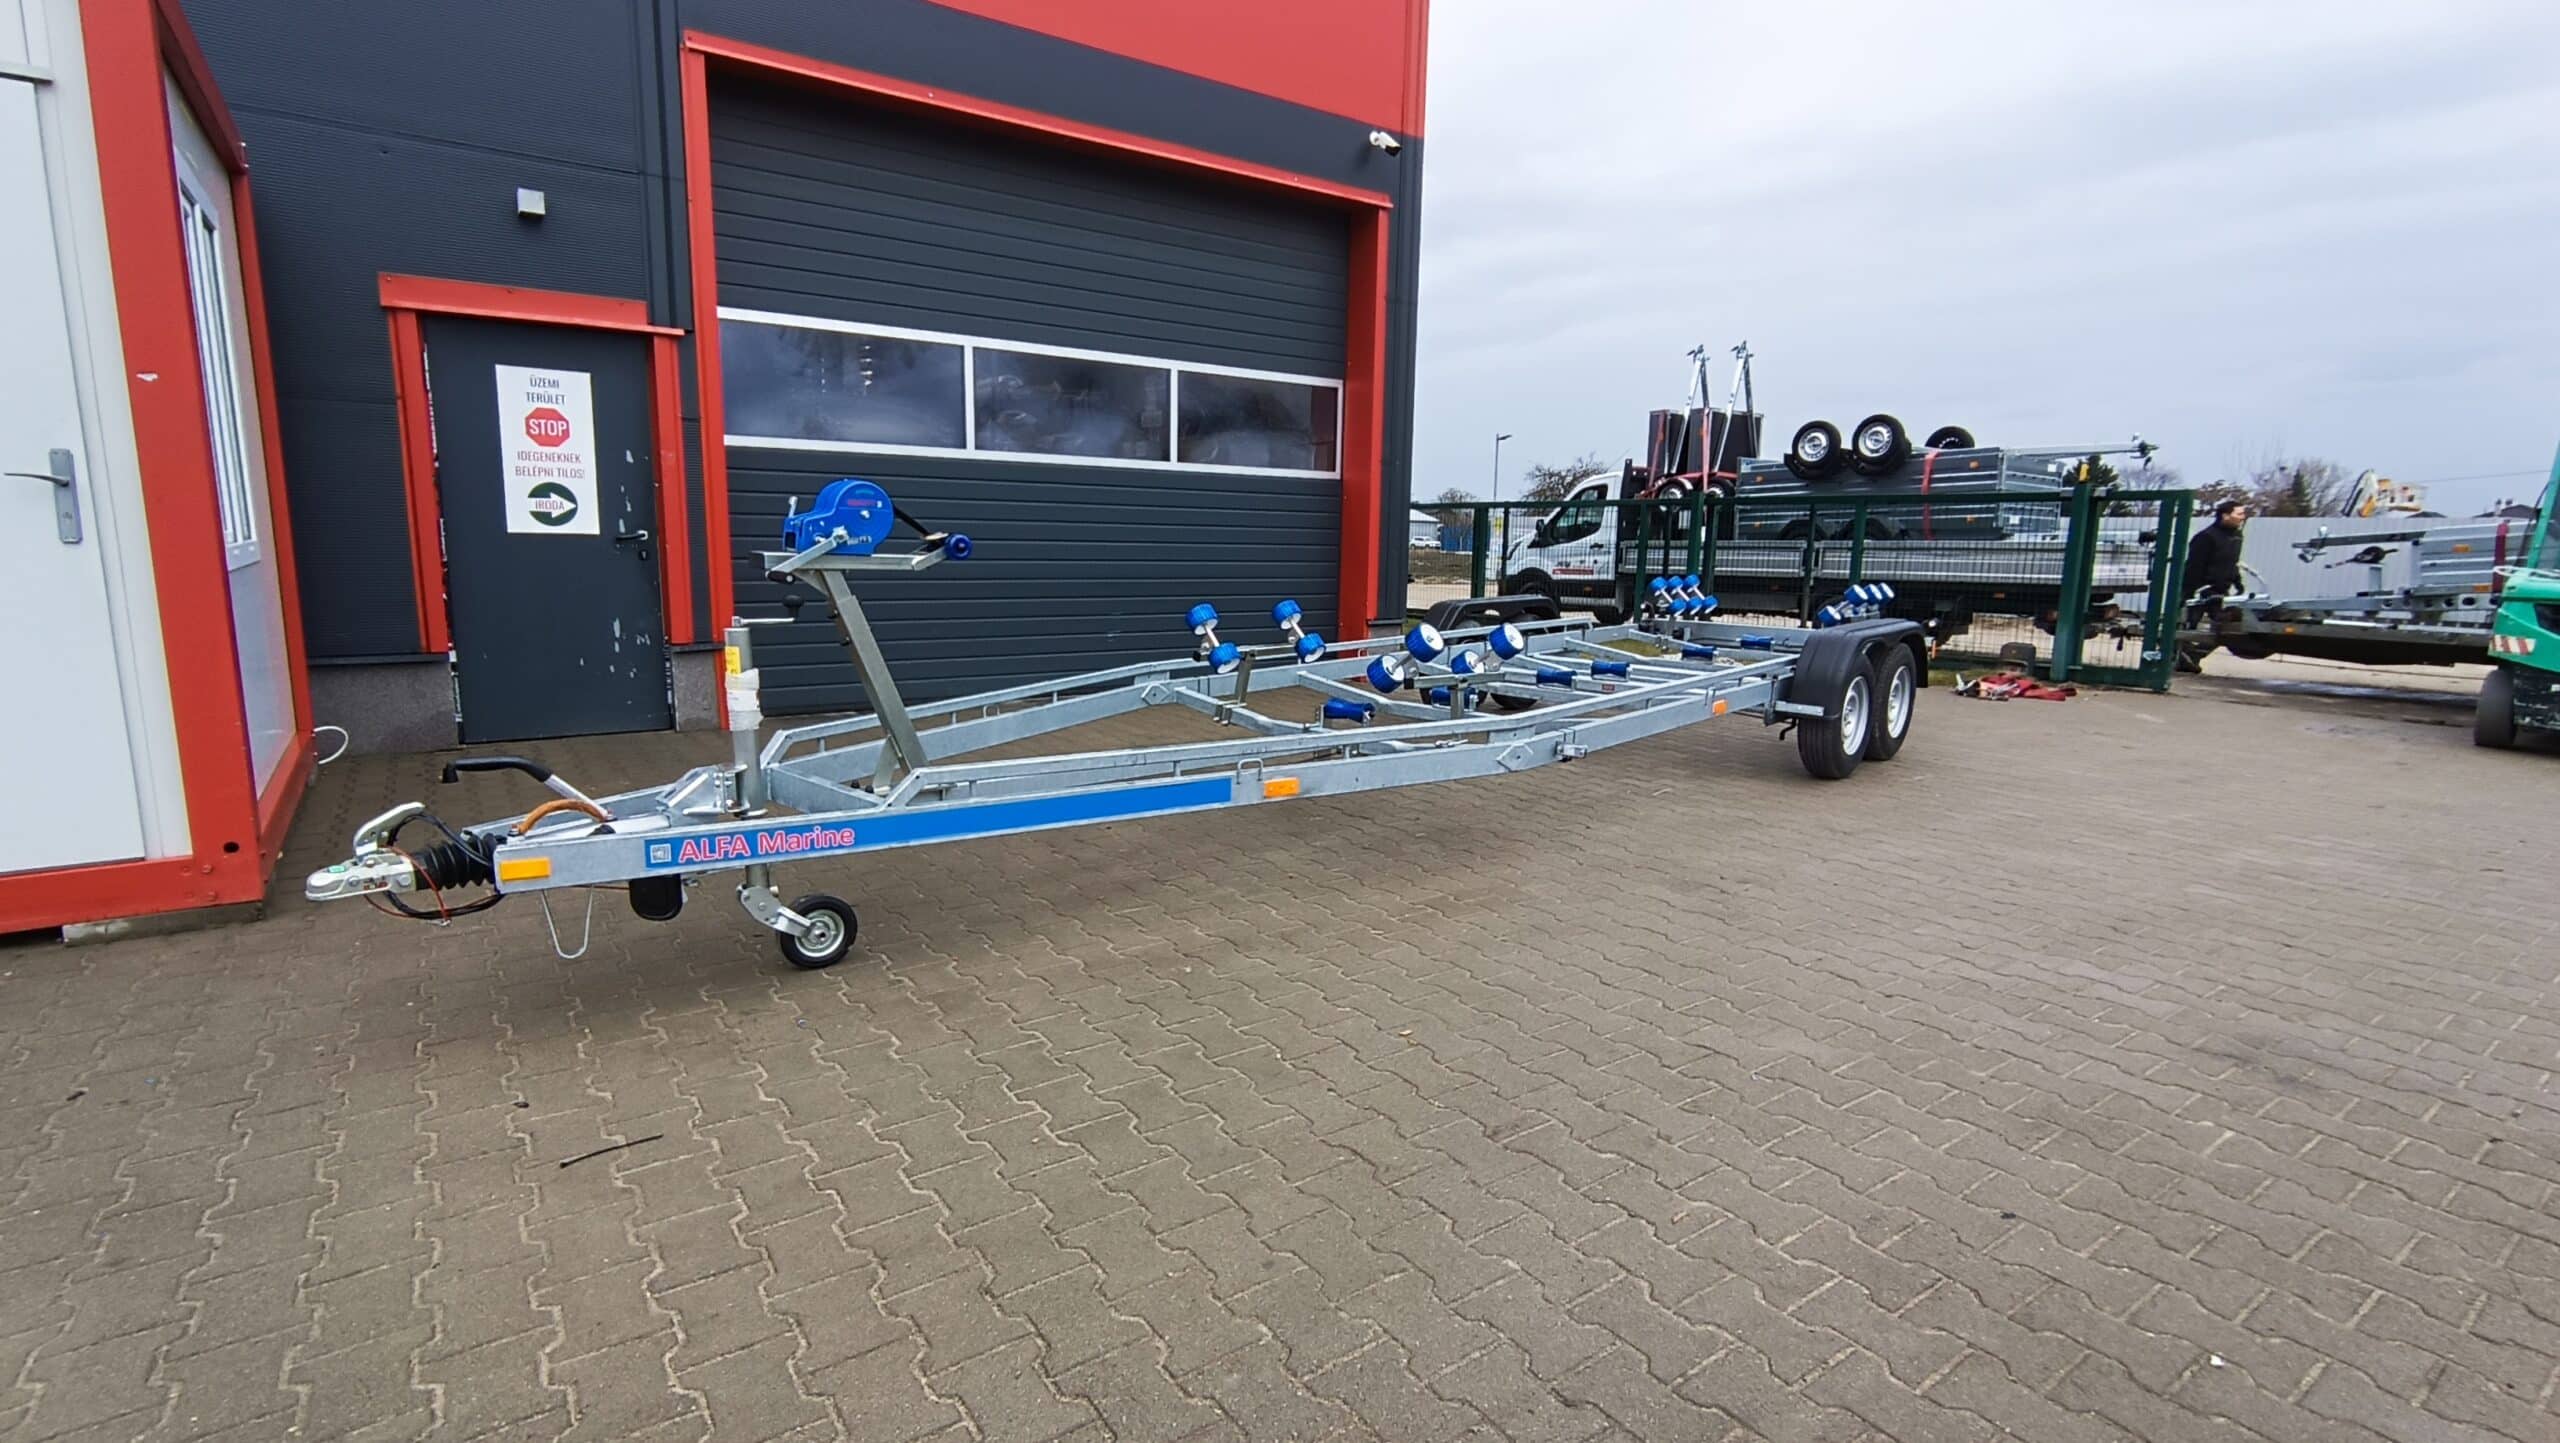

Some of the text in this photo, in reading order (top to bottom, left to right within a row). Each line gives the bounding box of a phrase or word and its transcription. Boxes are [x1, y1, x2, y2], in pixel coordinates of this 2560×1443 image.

[530, 375, 560, 388] ÜZEMI
[526, 391, 566, 405] TERÜLET
[529, 419, 567, 436] STOP
[517, 451, 581, 463] IDEGENEKNEK
[515, 465, 584, 479] BELÉPNI TILOS!
[535, 499, 565, 511] IRODA
[679, 826, 855, 863] ALFA Marine
